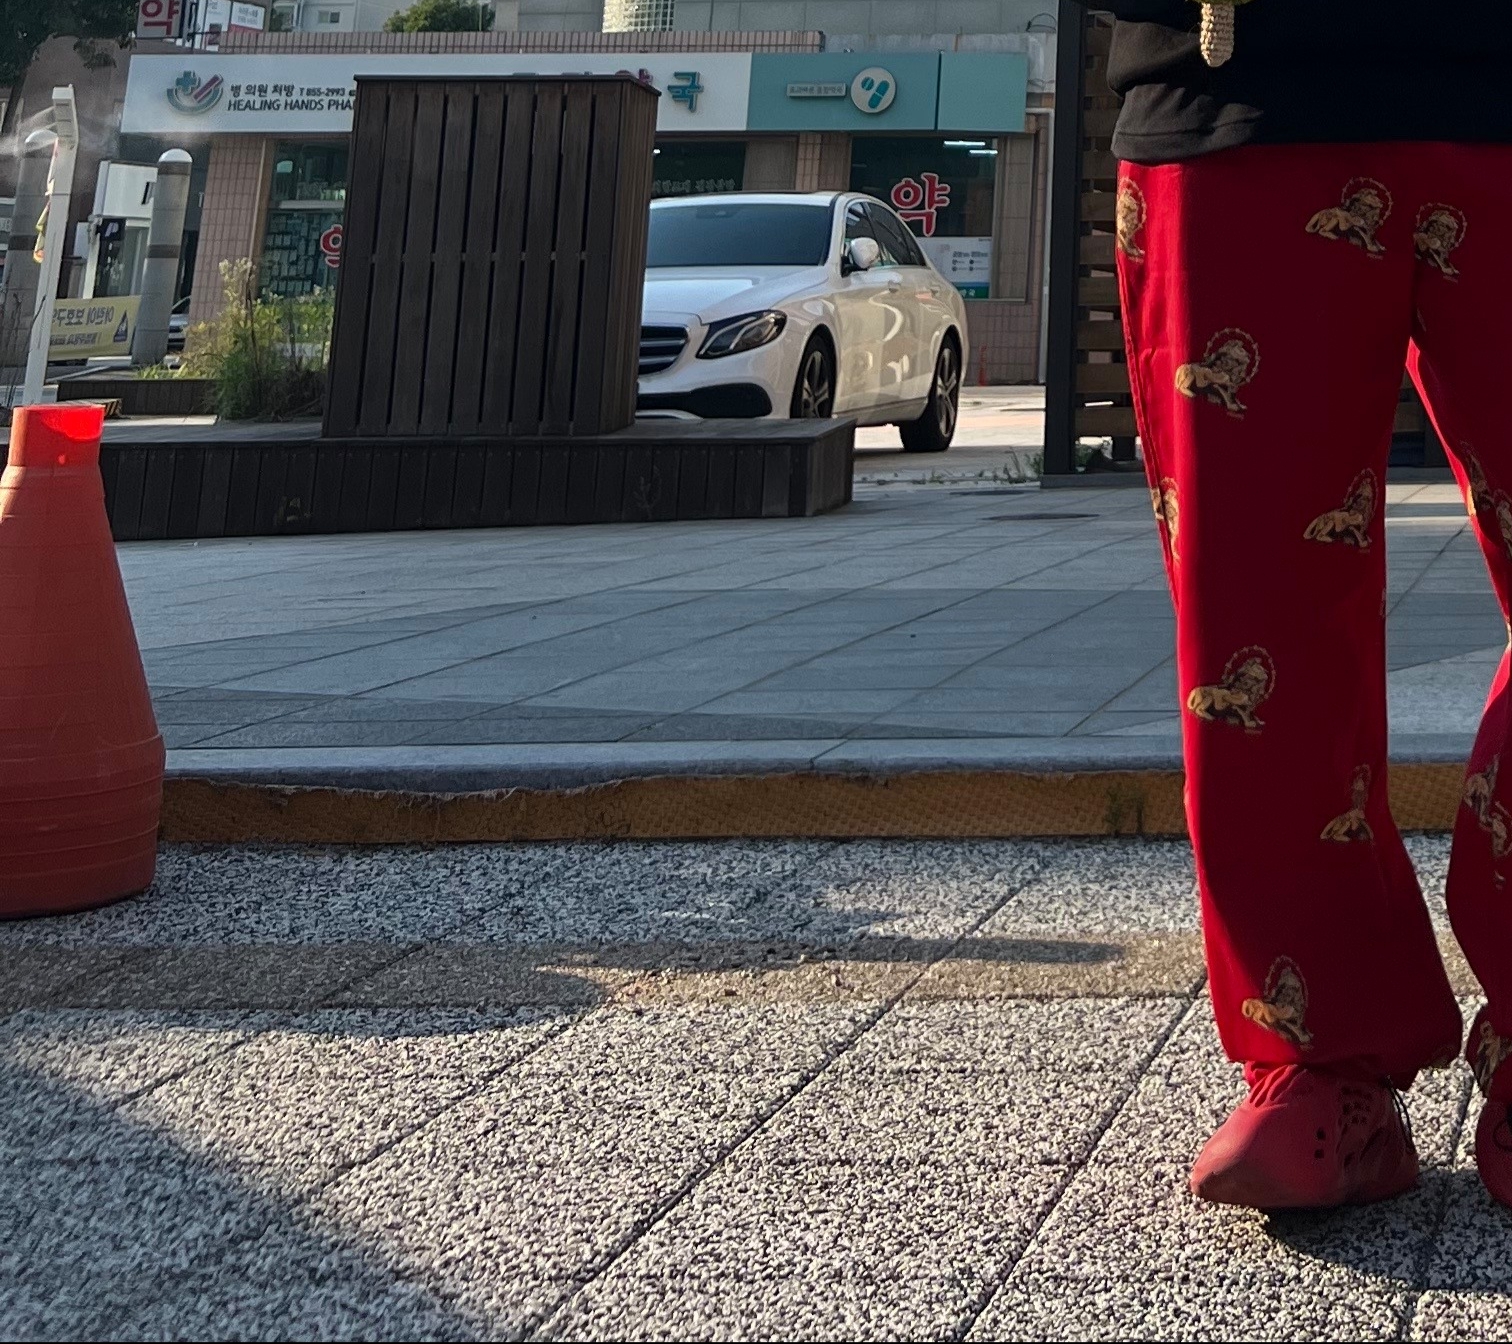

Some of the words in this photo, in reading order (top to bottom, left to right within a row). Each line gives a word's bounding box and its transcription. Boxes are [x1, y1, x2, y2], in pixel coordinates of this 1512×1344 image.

[227, 99, 281, 112] HEALING
[284, 99, 325, 111] HANDS
[327, 99, 355, 111] PHA
[890, 172, 951, 237] 약
